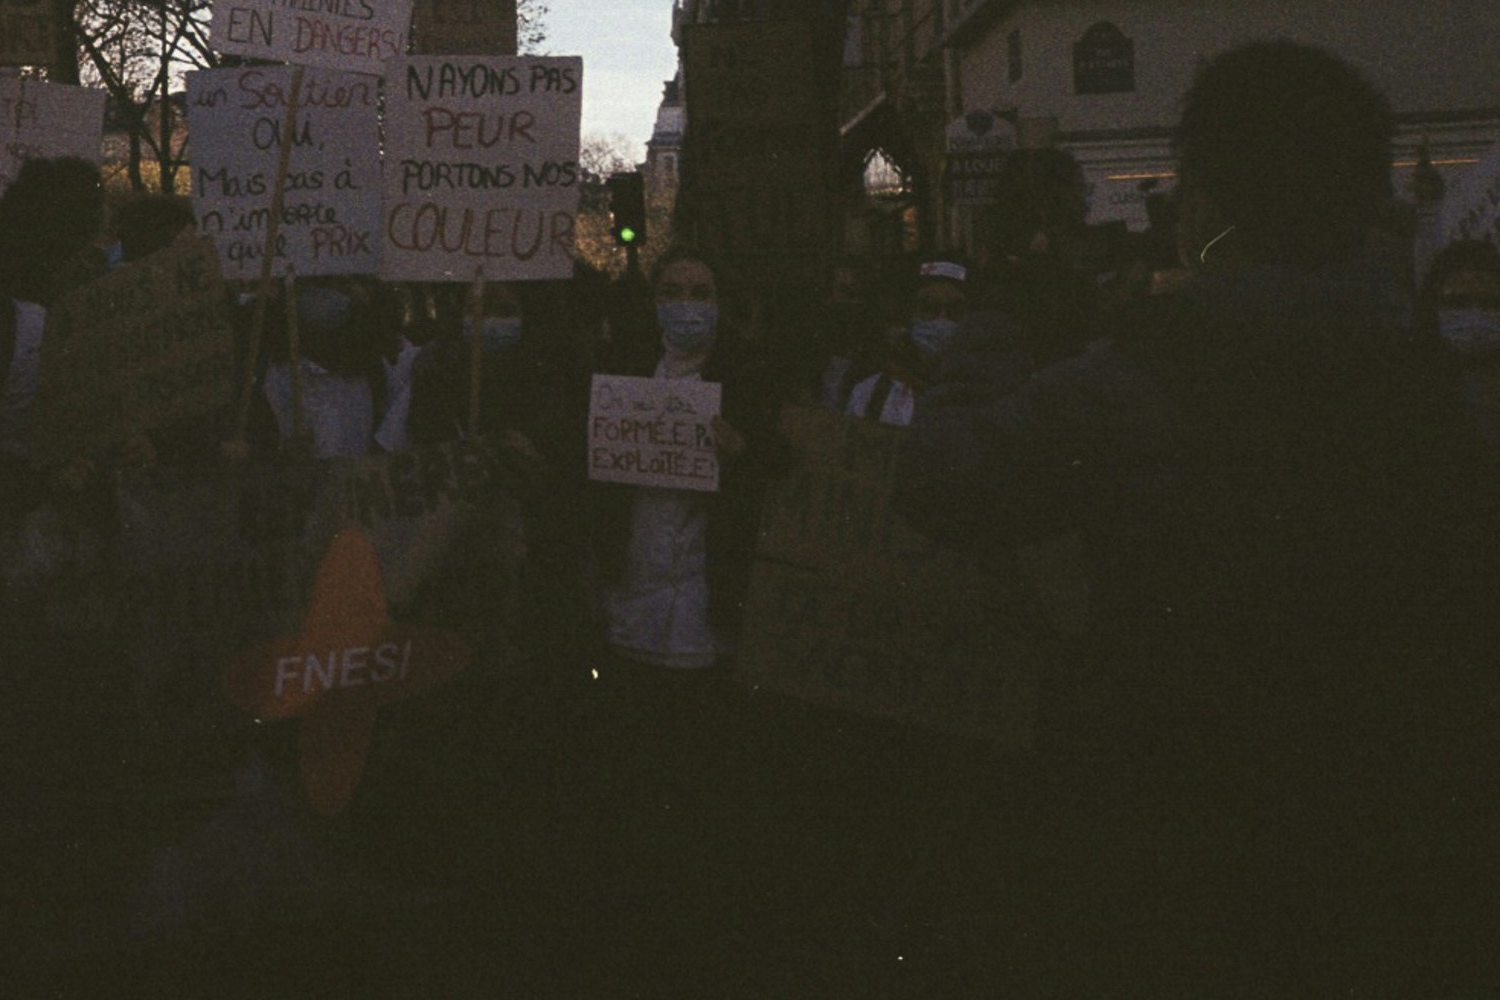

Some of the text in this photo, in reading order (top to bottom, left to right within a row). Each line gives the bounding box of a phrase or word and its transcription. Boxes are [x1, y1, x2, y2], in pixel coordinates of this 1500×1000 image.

[228, 6, 273, 47] EN
[530, 64, 577, 94] PAS
[422, 106, 537, 149] PEUR
[400, 158, 577, 196] PORTONS NOS
[388, 201, 577, 262] COULEUR
[273, 640, 414, 697] FNESI
